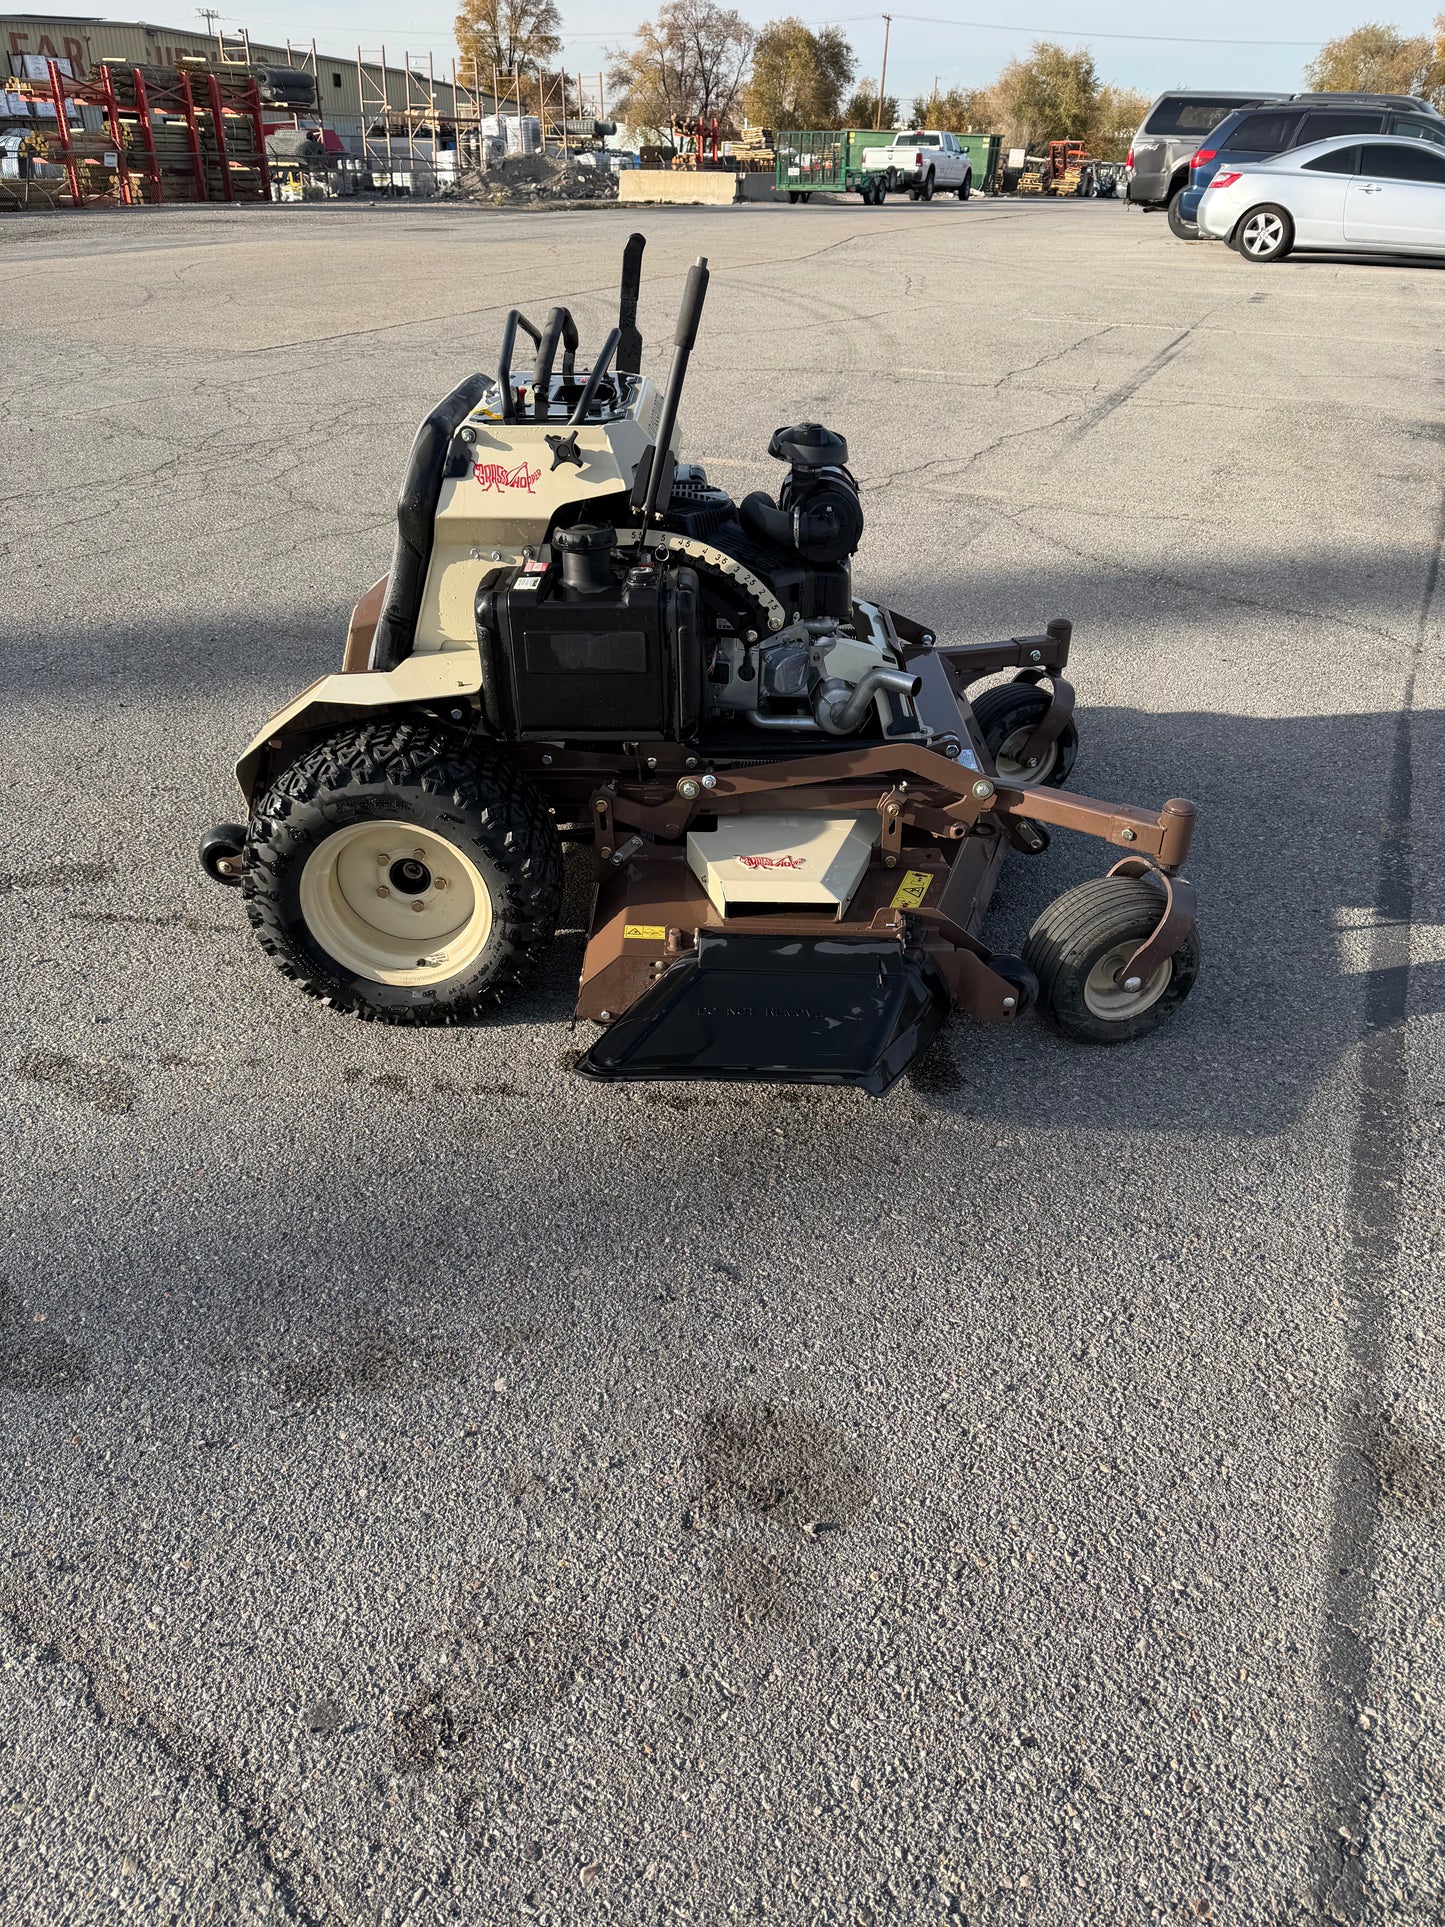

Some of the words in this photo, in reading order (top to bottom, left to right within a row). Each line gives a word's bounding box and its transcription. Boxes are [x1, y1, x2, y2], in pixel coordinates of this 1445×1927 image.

[660, 534, 667, 542] 5
[678, 539, 691, 548] 4.5
[715, 554, 728, 565] 3.5
[733, 565, 741, 573] 3
[744, 574, 757, 586] 2.5
[758, 588, 766, 596] 2
[767, 599, 779, 611] 1.5
